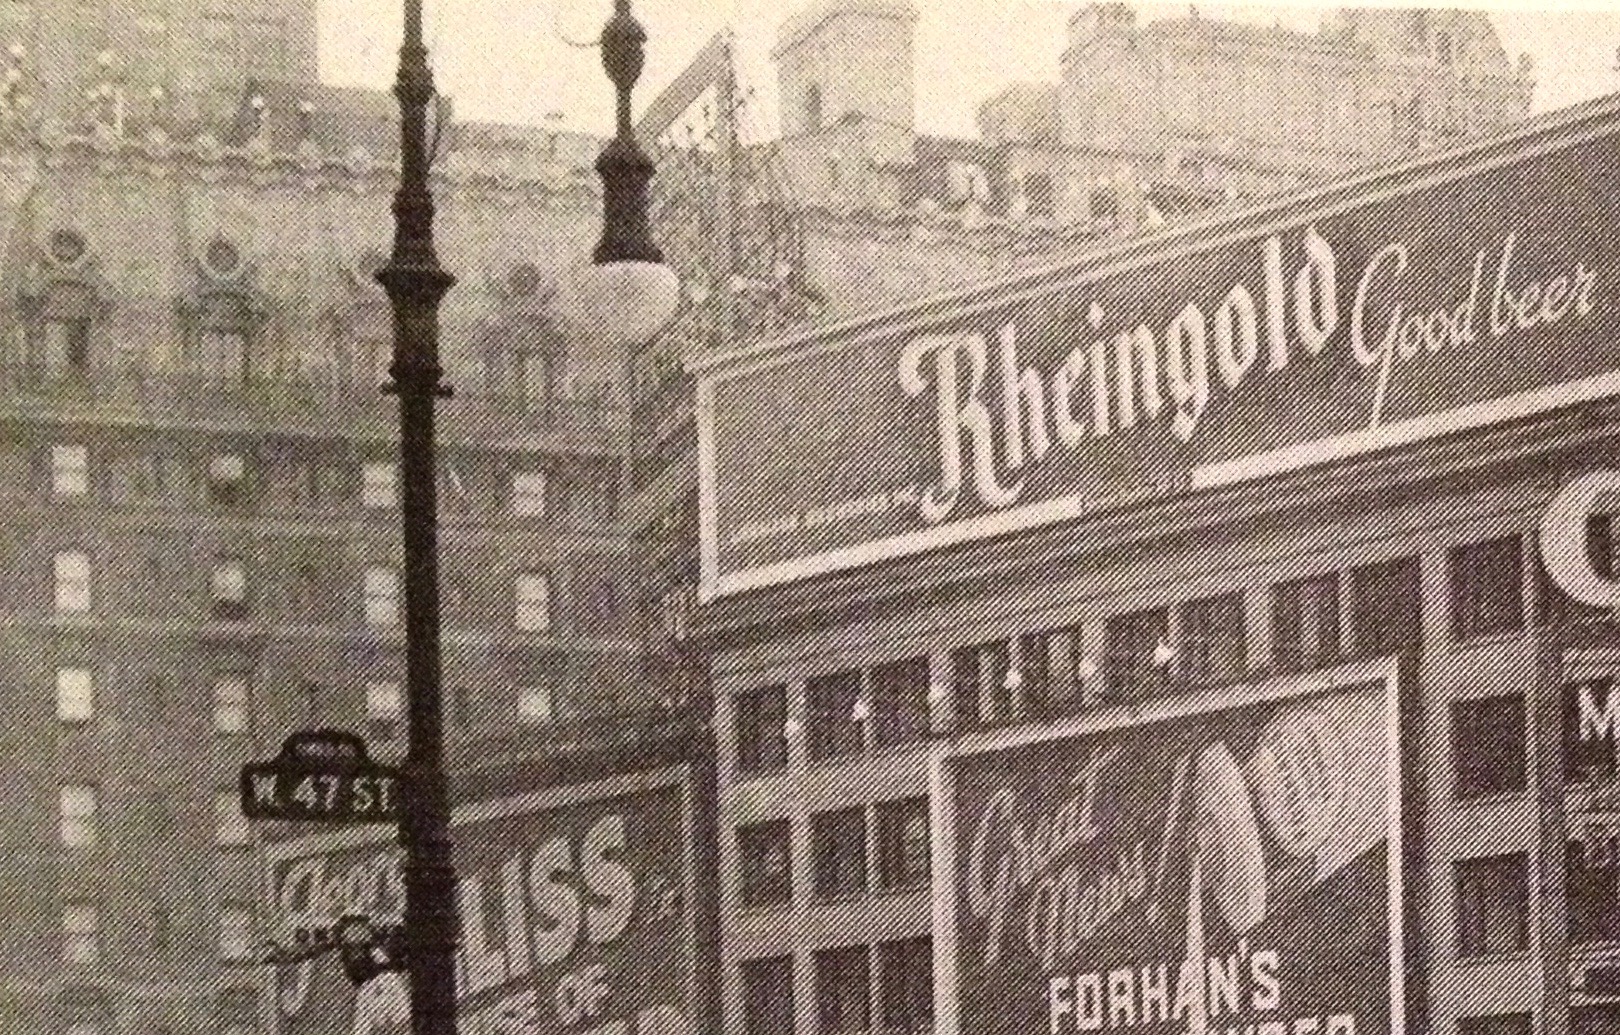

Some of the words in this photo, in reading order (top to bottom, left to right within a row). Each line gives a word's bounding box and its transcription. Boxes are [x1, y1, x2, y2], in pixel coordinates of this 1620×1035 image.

[898, 228, 1341, 524] Rheingold
[1351, 243, 1488, 428] Good
[1490, 234, 1598, 341] beer
[253, 776, 276, 801] W
[294, 775, 338, 809] 47
[967, 743, 1123, 967] Great
[556, 963, 610, 1027] OF
[1048, 937, 1282, 1035] FORHAN'S
